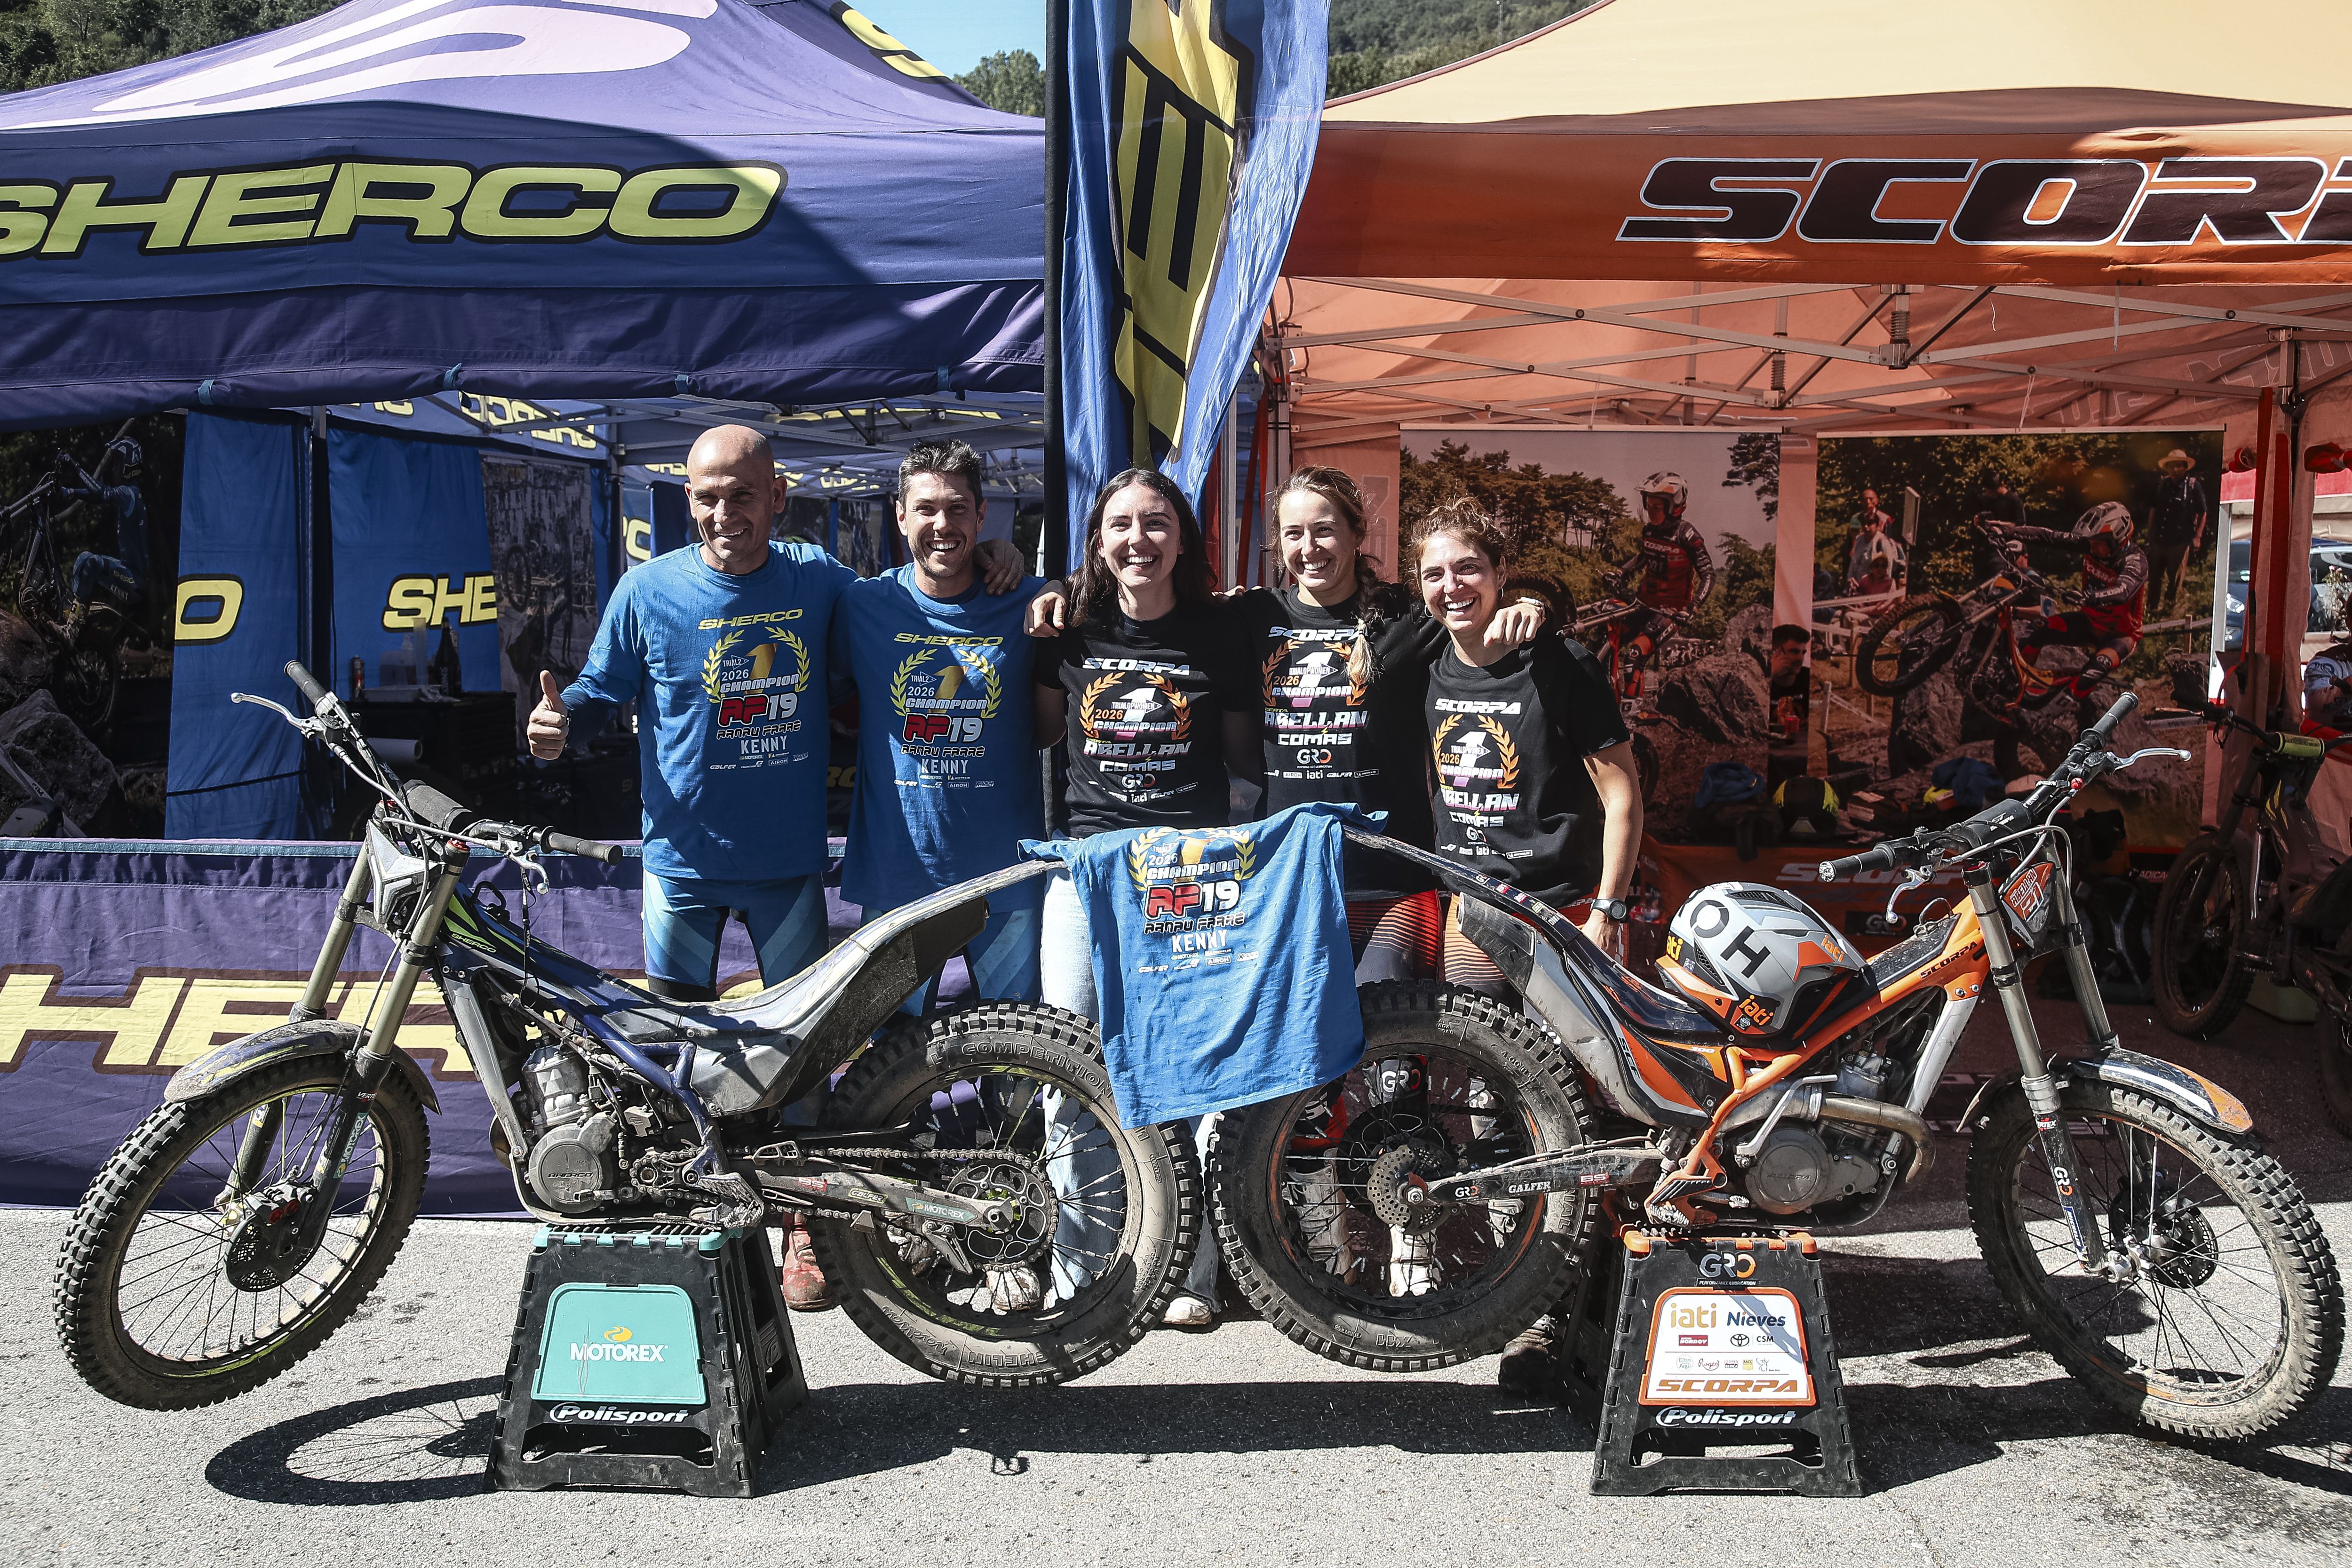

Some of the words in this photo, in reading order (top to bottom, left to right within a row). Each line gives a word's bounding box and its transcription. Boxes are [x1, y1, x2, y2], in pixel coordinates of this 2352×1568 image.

[1615, 157, 2352, 246] SCOR
[383, 574, 498, 629] SHE
[698, 609, 803, 630] SHERCO
[894, 633, 1003, 647] SHERCO
[723, 658, 742, 667] TRIAL2
[1082, 658, 1190, 676] SCORPA
[722, 669, 749, 681] 2026
[1289, 667, 1330, 676] TRIALGPWOMEN
[720, 673, 800, 693] CHAMPION
[1273, 676, 1300, 686] 2026
[907, 686, 935, 697] 2026
[1272, 685, 1352, 698] CHAMPION
[906, 698, 988, 709] CHAMPION
[1112, 701, 1155, 710] TRIALGPWOMEN
[1435, 698, 1522, 715] SCORPA
[1095, 709, 1124, 720] 2026
[1264, 710, 1368, 730] ABELLAN
[1093, 721, 1177, 732] CHAMPION
[741, 736, 787, 754] KENNY
[1278, 732, 1352, 746] COMAS
[1083, 740, 1192, 758] ABELLAN
[1099, 759, 1176, 772] COMAS
[1441, 753, 1460, 764] 2026
[921, 759, 969, 774] KENNY
[1441, 765, 1504, 780] CHAMPION
[1307, 770, 1323, 780] iati
[1449, 811, 1504, 827] COMAS
[1476, 846, 1490, 855] iati
[1148, 852, 1178, 866] 2026
[1146, 858, 1241, 881] CHAMPION
[2140, 870, 2168, 879] ADICA
[2010, 868, 2038, 908] ABELLAN
[451, 933, 497, 953] SHERCO
[1172, 930, 1227, 953] KENNY
[1667, 935, 1684, 961] ati
[1821, 934, 1844, 963] iati
[1920, 941, 1978, 980] SCORPA
[1739, 995, 1774, 1026] iati
[961, 1042, 1113, 1099] COMPETITION
[341, 1115, 366, 1163] MOTOREX
[1580, 1173, 1607, 1182] BS
[850, 1189, 884, 1201] GALFER
[1508, 1181, 1551, 1194] GALFER
[924, 1204, 966, 1219] MOTOREX
[1671, 1303, 1716, 1328] iati
[1727, 1311, 1786, 1328] Nieves
[570, 1342, 665, 1362] MOTOREX
[967, 1349, 1049, 1366] CHELIN
[1655, 1379, 1798, 1393] SCORPA
[549, 1402, 689, 1424] Polisport
[1656, 1406, 1796, 1427] Polisport
